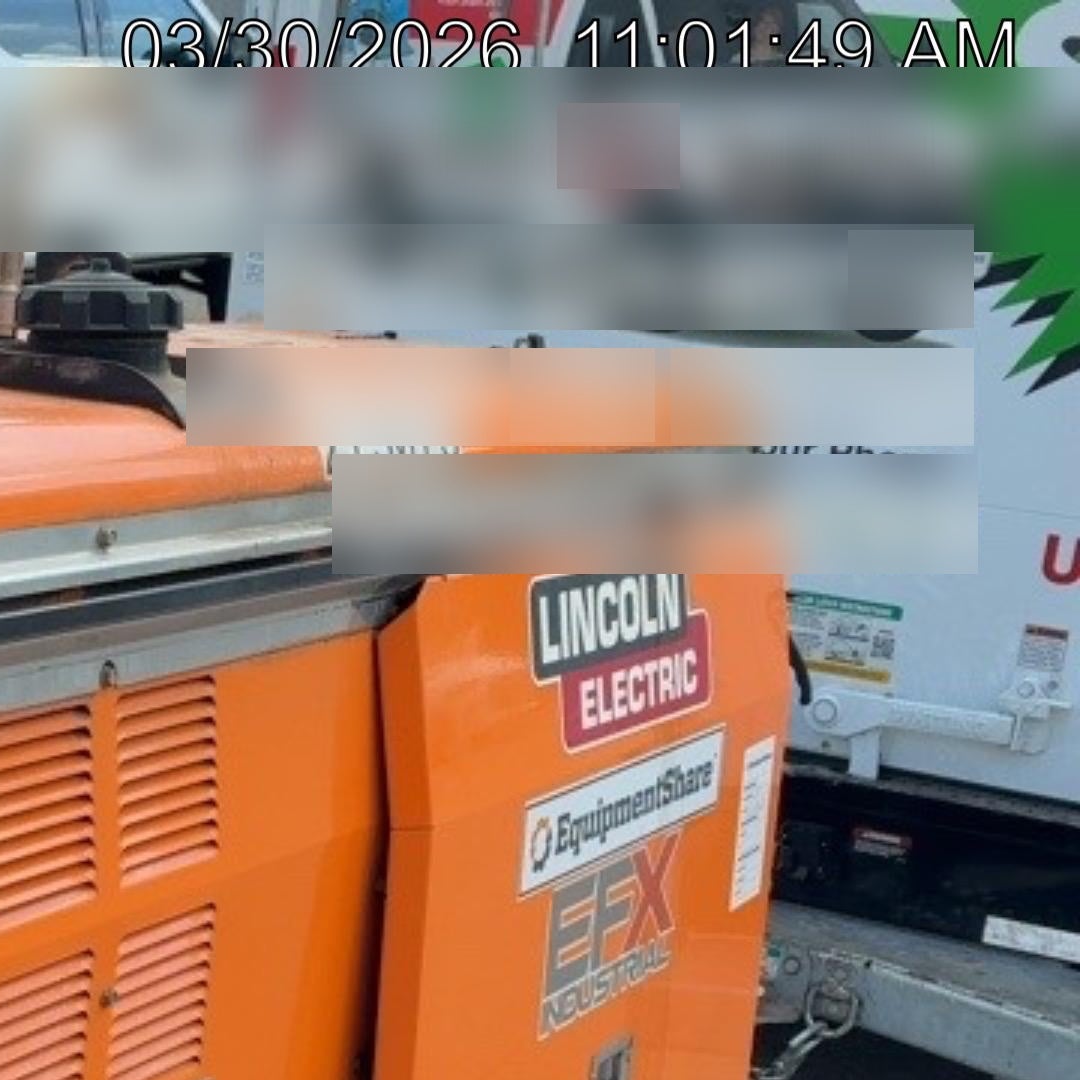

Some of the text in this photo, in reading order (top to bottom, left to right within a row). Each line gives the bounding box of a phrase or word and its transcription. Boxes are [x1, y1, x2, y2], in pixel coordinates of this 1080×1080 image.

[539, 573, 681, 665] LINCOLN
[580, 647, 698, 731] ELECTRIC
[554, 759, 713, 857] EquipmentShare
[545, 831, 682, 997] EFX
